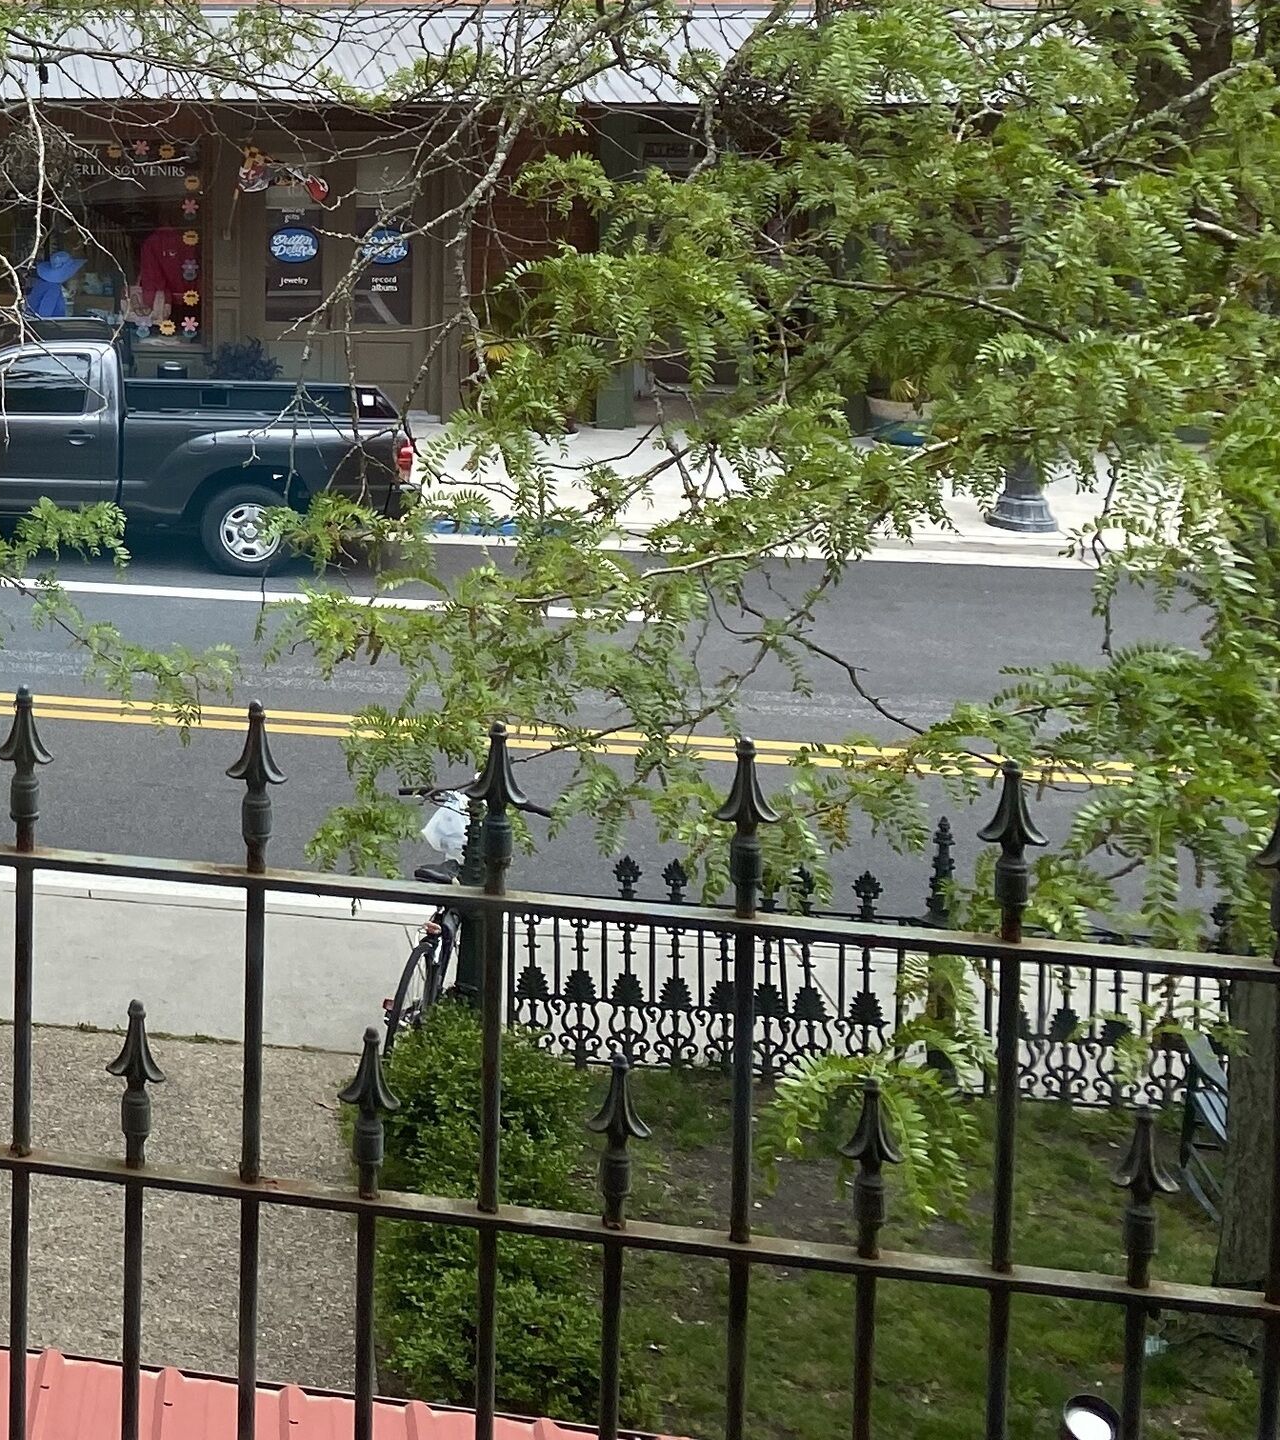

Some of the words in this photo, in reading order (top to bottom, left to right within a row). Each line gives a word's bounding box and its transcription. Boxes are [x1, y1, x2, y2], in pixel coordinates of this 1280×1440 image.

[115, 164, 185, 176] SOUVENIRS
[279, 276, 309, 286] jewelry
[371, 276, 397, 284] record
[371, 284, 398, 292] albums
